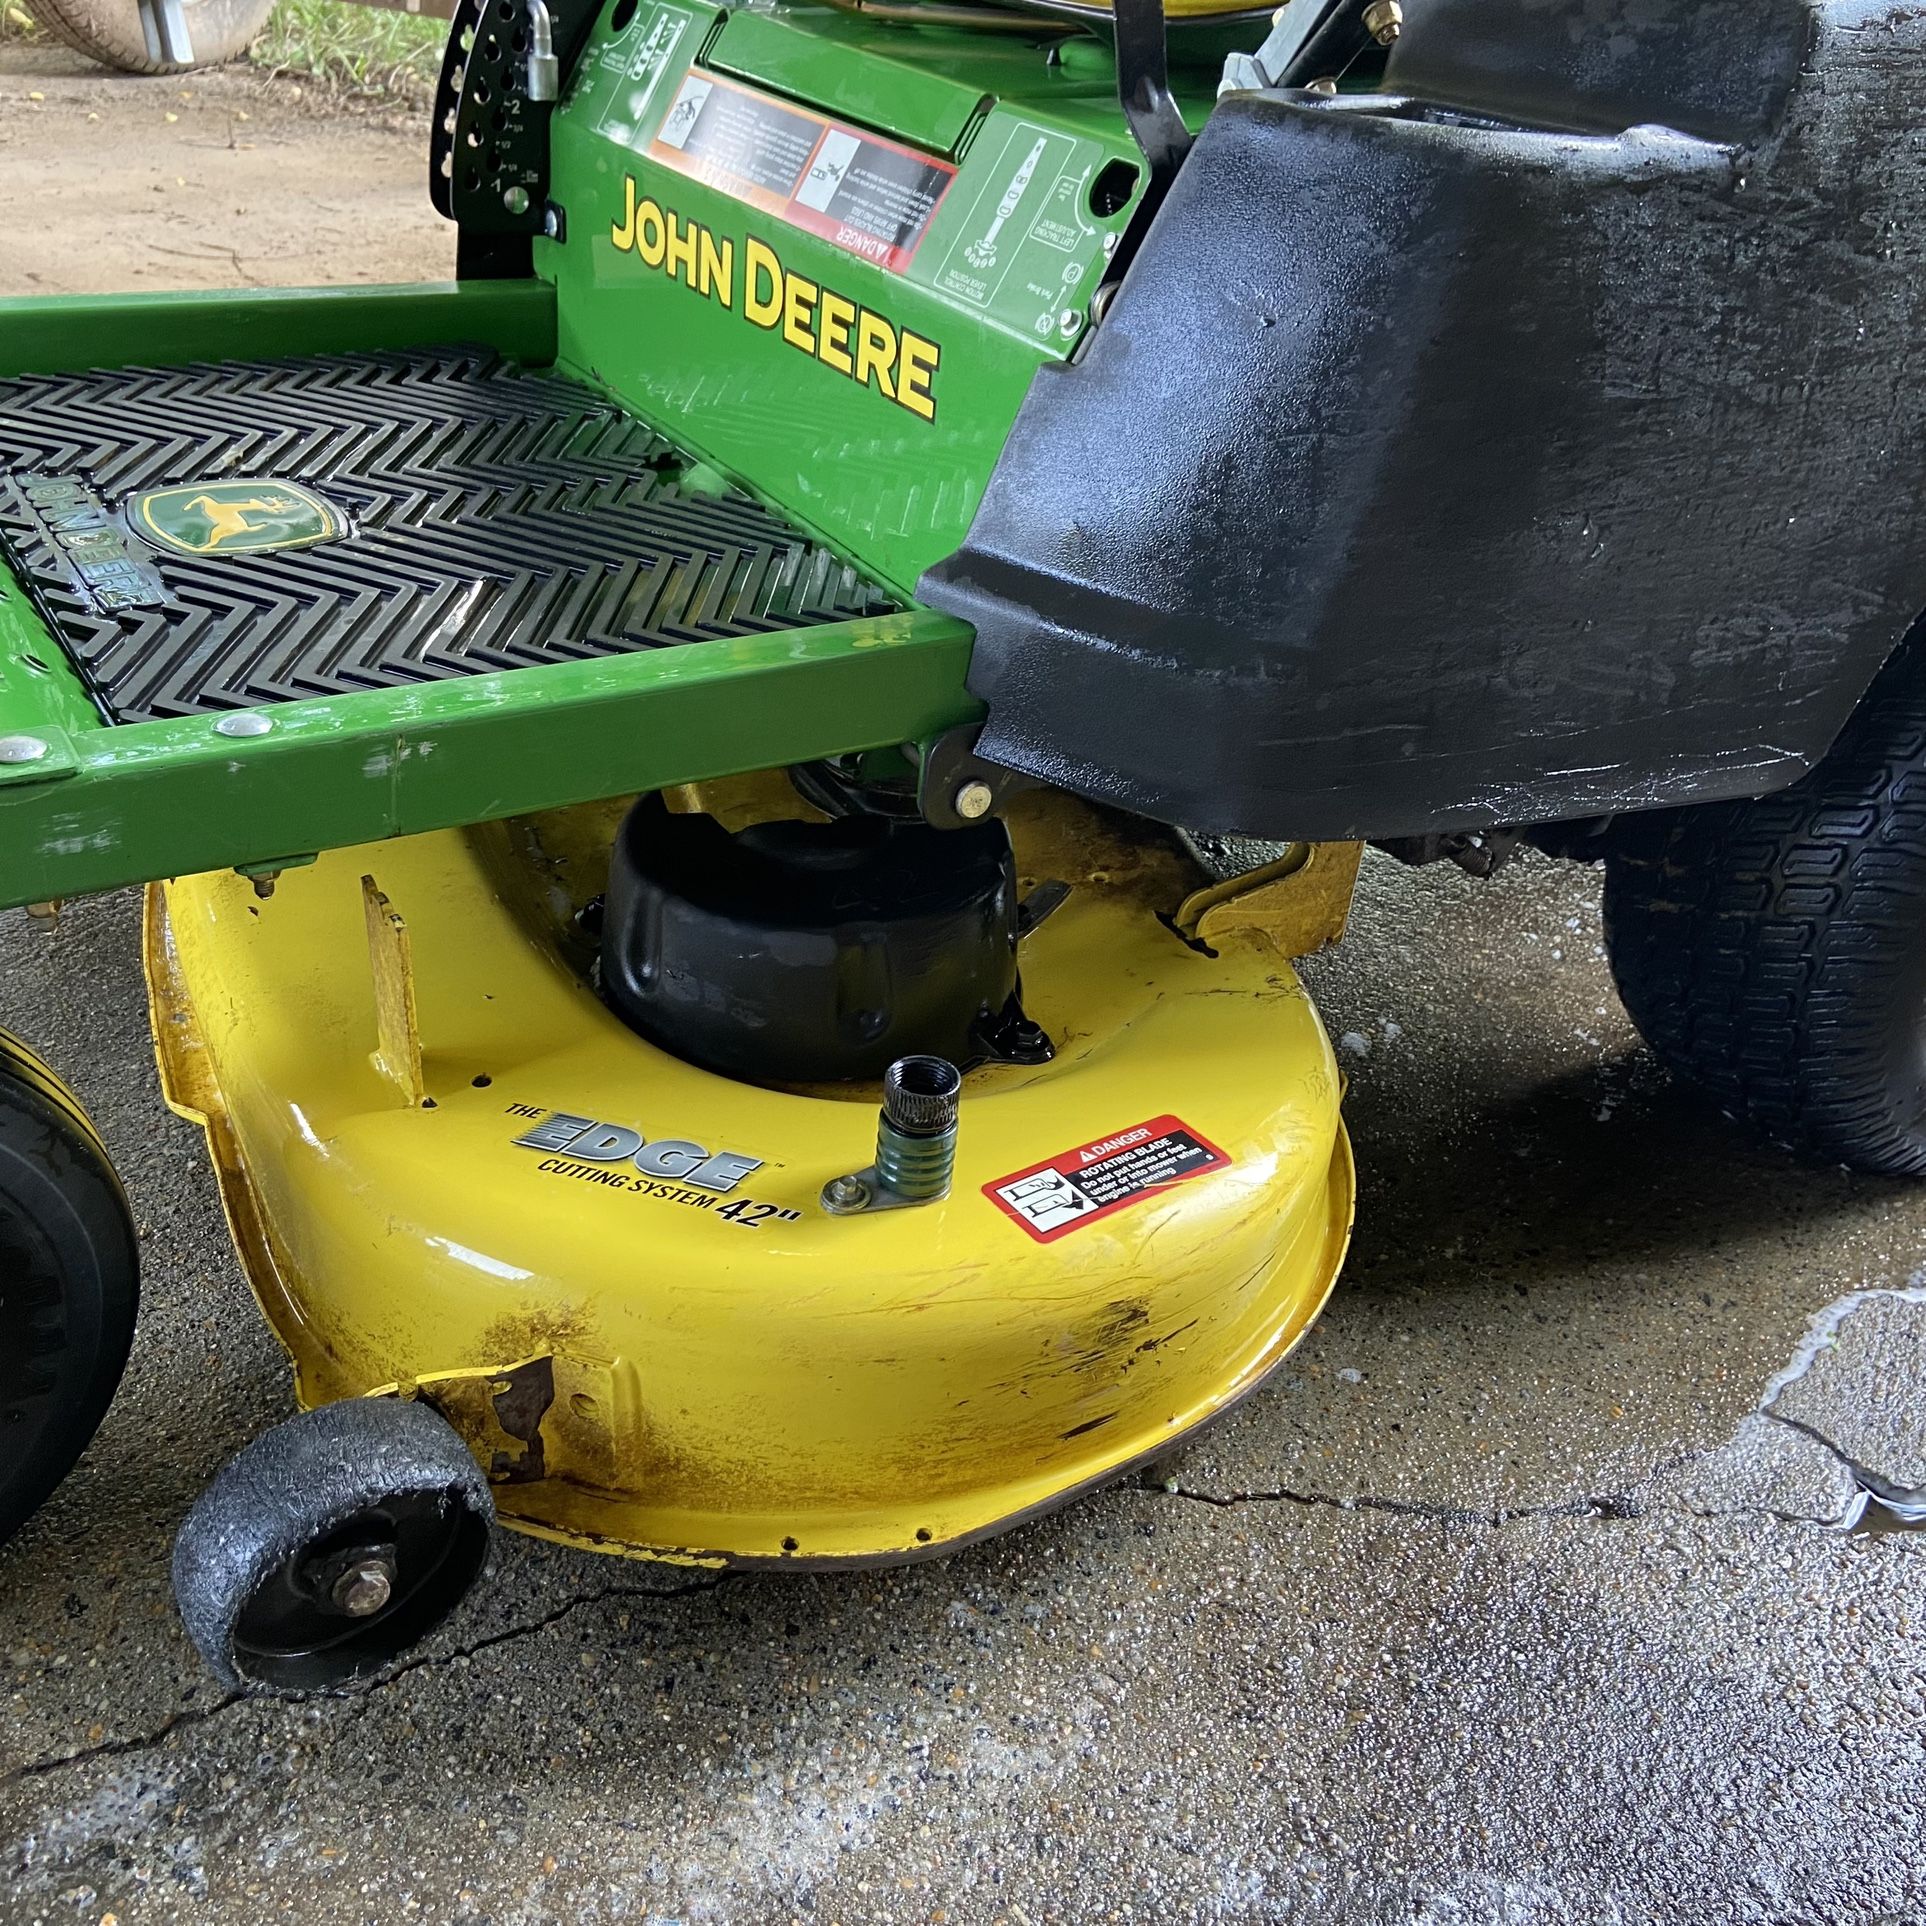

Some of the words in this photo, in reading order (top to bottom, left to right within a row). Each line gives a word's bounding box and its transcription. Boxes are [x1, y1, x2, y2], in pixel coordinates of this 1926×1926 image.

[511, 99, 520, 114] 2
[495, 178, 501, 192] 1
[835, 225, 878, 255] DANGER
[1059, 236, 1075, 248] LEFT
[611, 172, 734, 311] JOHN
[743, 233, 941, 425] DEERE
[505, 1103, 547, 1119] THE
[510, 1112, 765, 1193] EDGE
[1078, 1151, 1137, 1178] ROTATING
[1133, 1136, 1173, 1156] BLADE
[1090, 1126, 1152, 1156] DANGER
[537, 1158, 631, 1189] CUTTING
[628, 1179, 719, 1209] SYSTEM
[1080, 1178, 1098, 1189] Do
[1095, 1171, 1115, 1183] not
[1112, 1166, 1131, 1177] put
[1128, 1154, 1158, 1170] hands
[1156, 1151, 1169, 1159] or
[1166, 1142, 1187, 1154] feet
[1088, 1180, 1118, 1195] under
[1117, 1176, 1129, 1184] or
[1127, 1167, 1149, 1179] into
[1147, 1156, 1178, 1172] mower
[1176, 1146, 1202, 1160] when
[1096, 1185, 1132, 1203] engine
[1138, 1166, 1177, 1185] running
